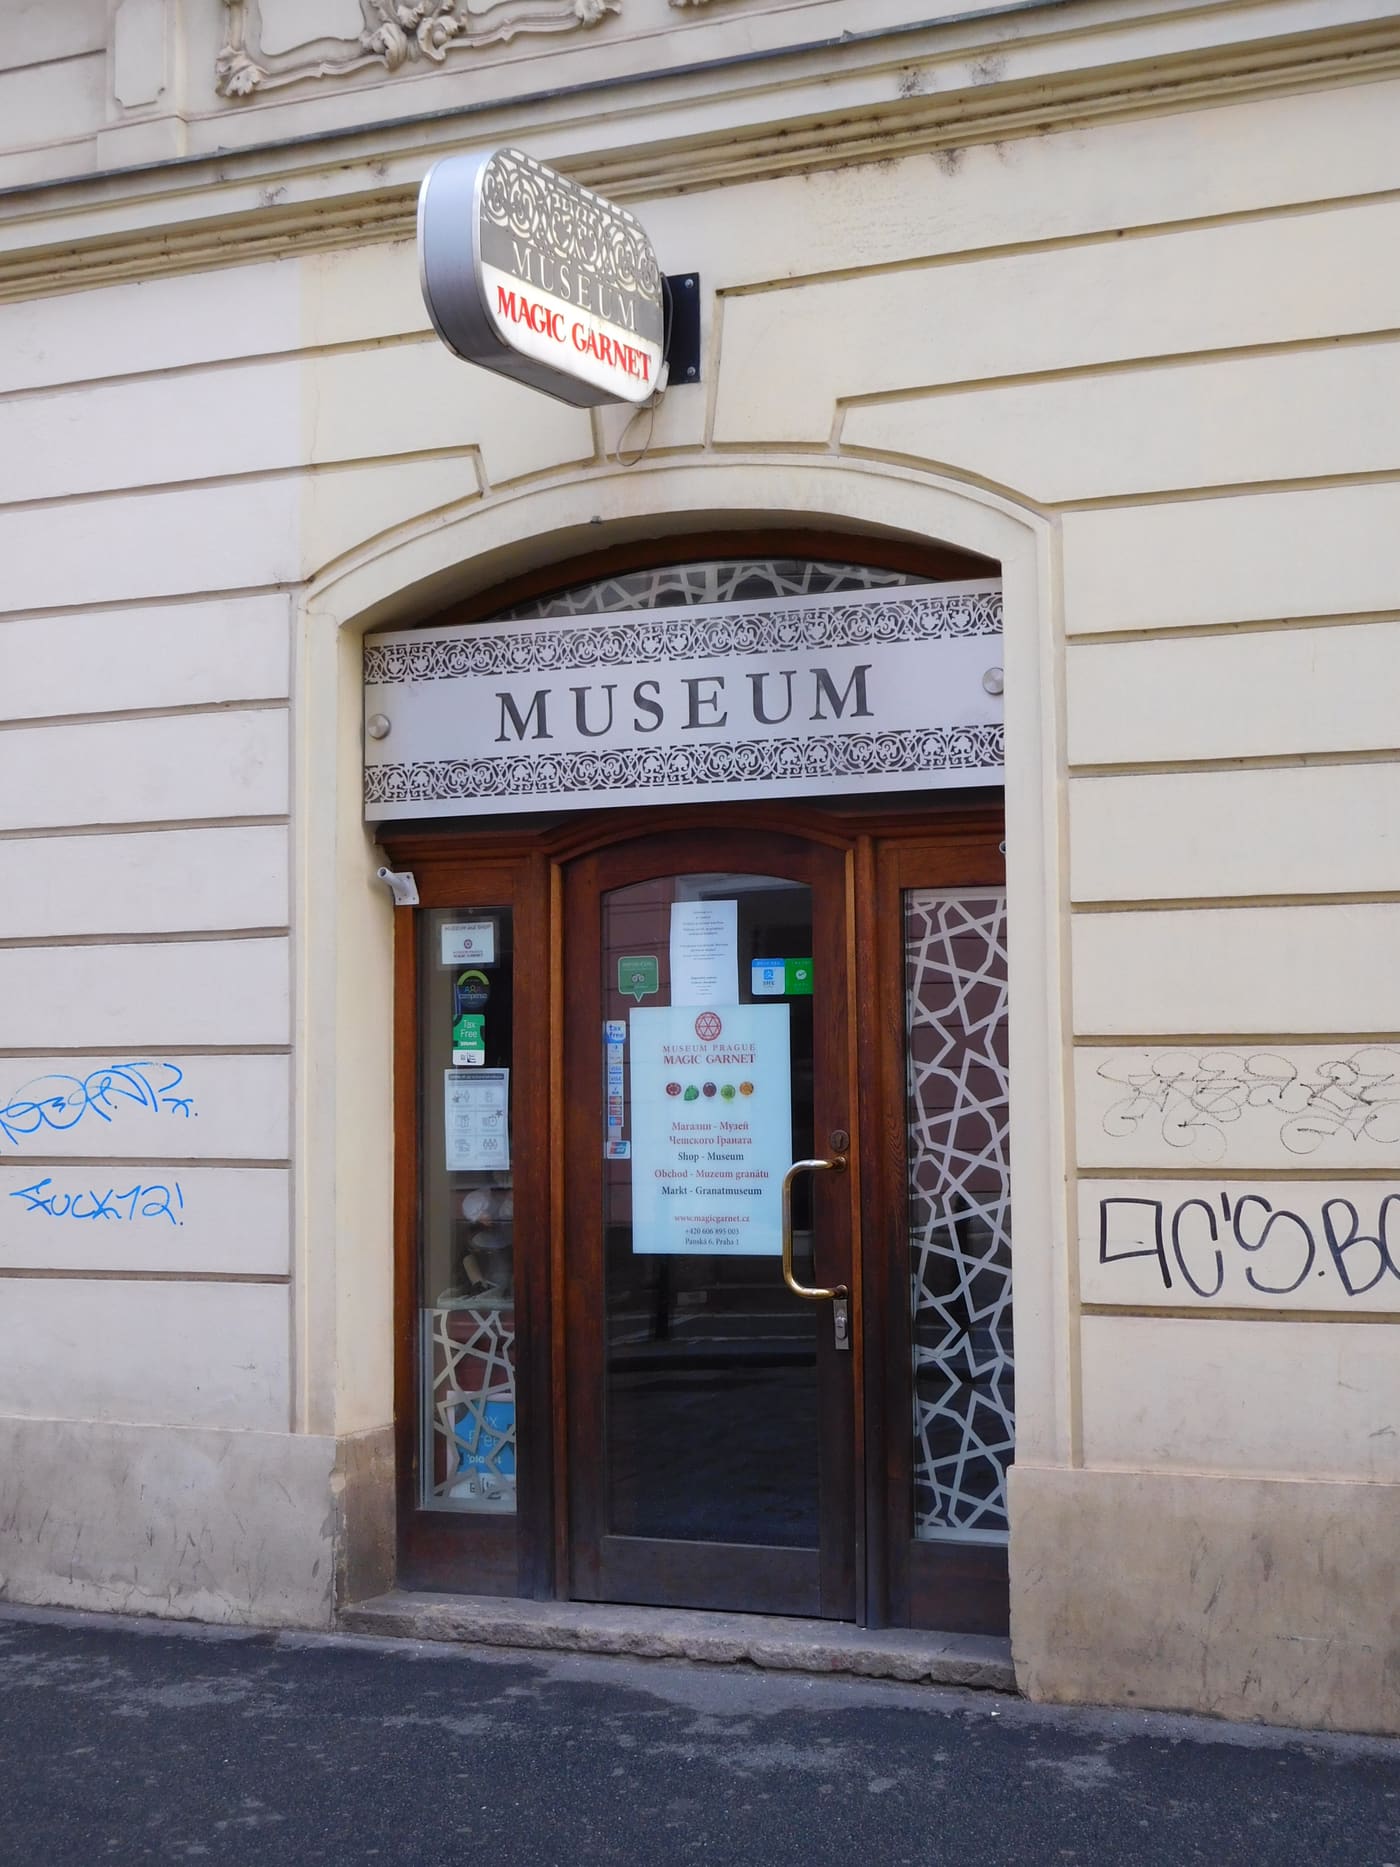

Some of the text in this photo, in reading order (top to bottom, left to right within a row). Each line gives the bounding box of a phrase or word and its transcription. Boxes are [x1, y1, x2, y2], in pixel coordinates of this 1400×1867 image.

[511, 240, 637, 330] MUSEUM
[496, 286, 652, 381] MAGIC GARNET
[494, 664, 875, 743] MUSEUM
[463, 1020, 476, 1029] Tax
[460, 1029, 478, 1038] Free
[663, 1043, 756, 1053] MUSEUM PRAGUE
[663, 1053, 756, 1064] MAGIC GARNET
[671, 1121, 712, 1131] Магазин
[719, 1121, 749, 1132] Музей
[669, 1135, 753, 1147] Чешского Граната
[678, 1152, 699, 1163] Shop
[707, 1151, 744, 1161] Museum
[654, 1169, 688, 1178] Obchod
[696, 1169, 733, 1178] Muzeum
[735, 1169, 769, 1180] granátu
[661, 1186, 687, 1195] Markt
[695, 1186, 762, 1195] Granatmuseum
[674, 1214, 750, 1224] www.magicgarnet.cz
[701, 1227, 714, 1235] 606
[716, 1238, 734, 1246] Praha
